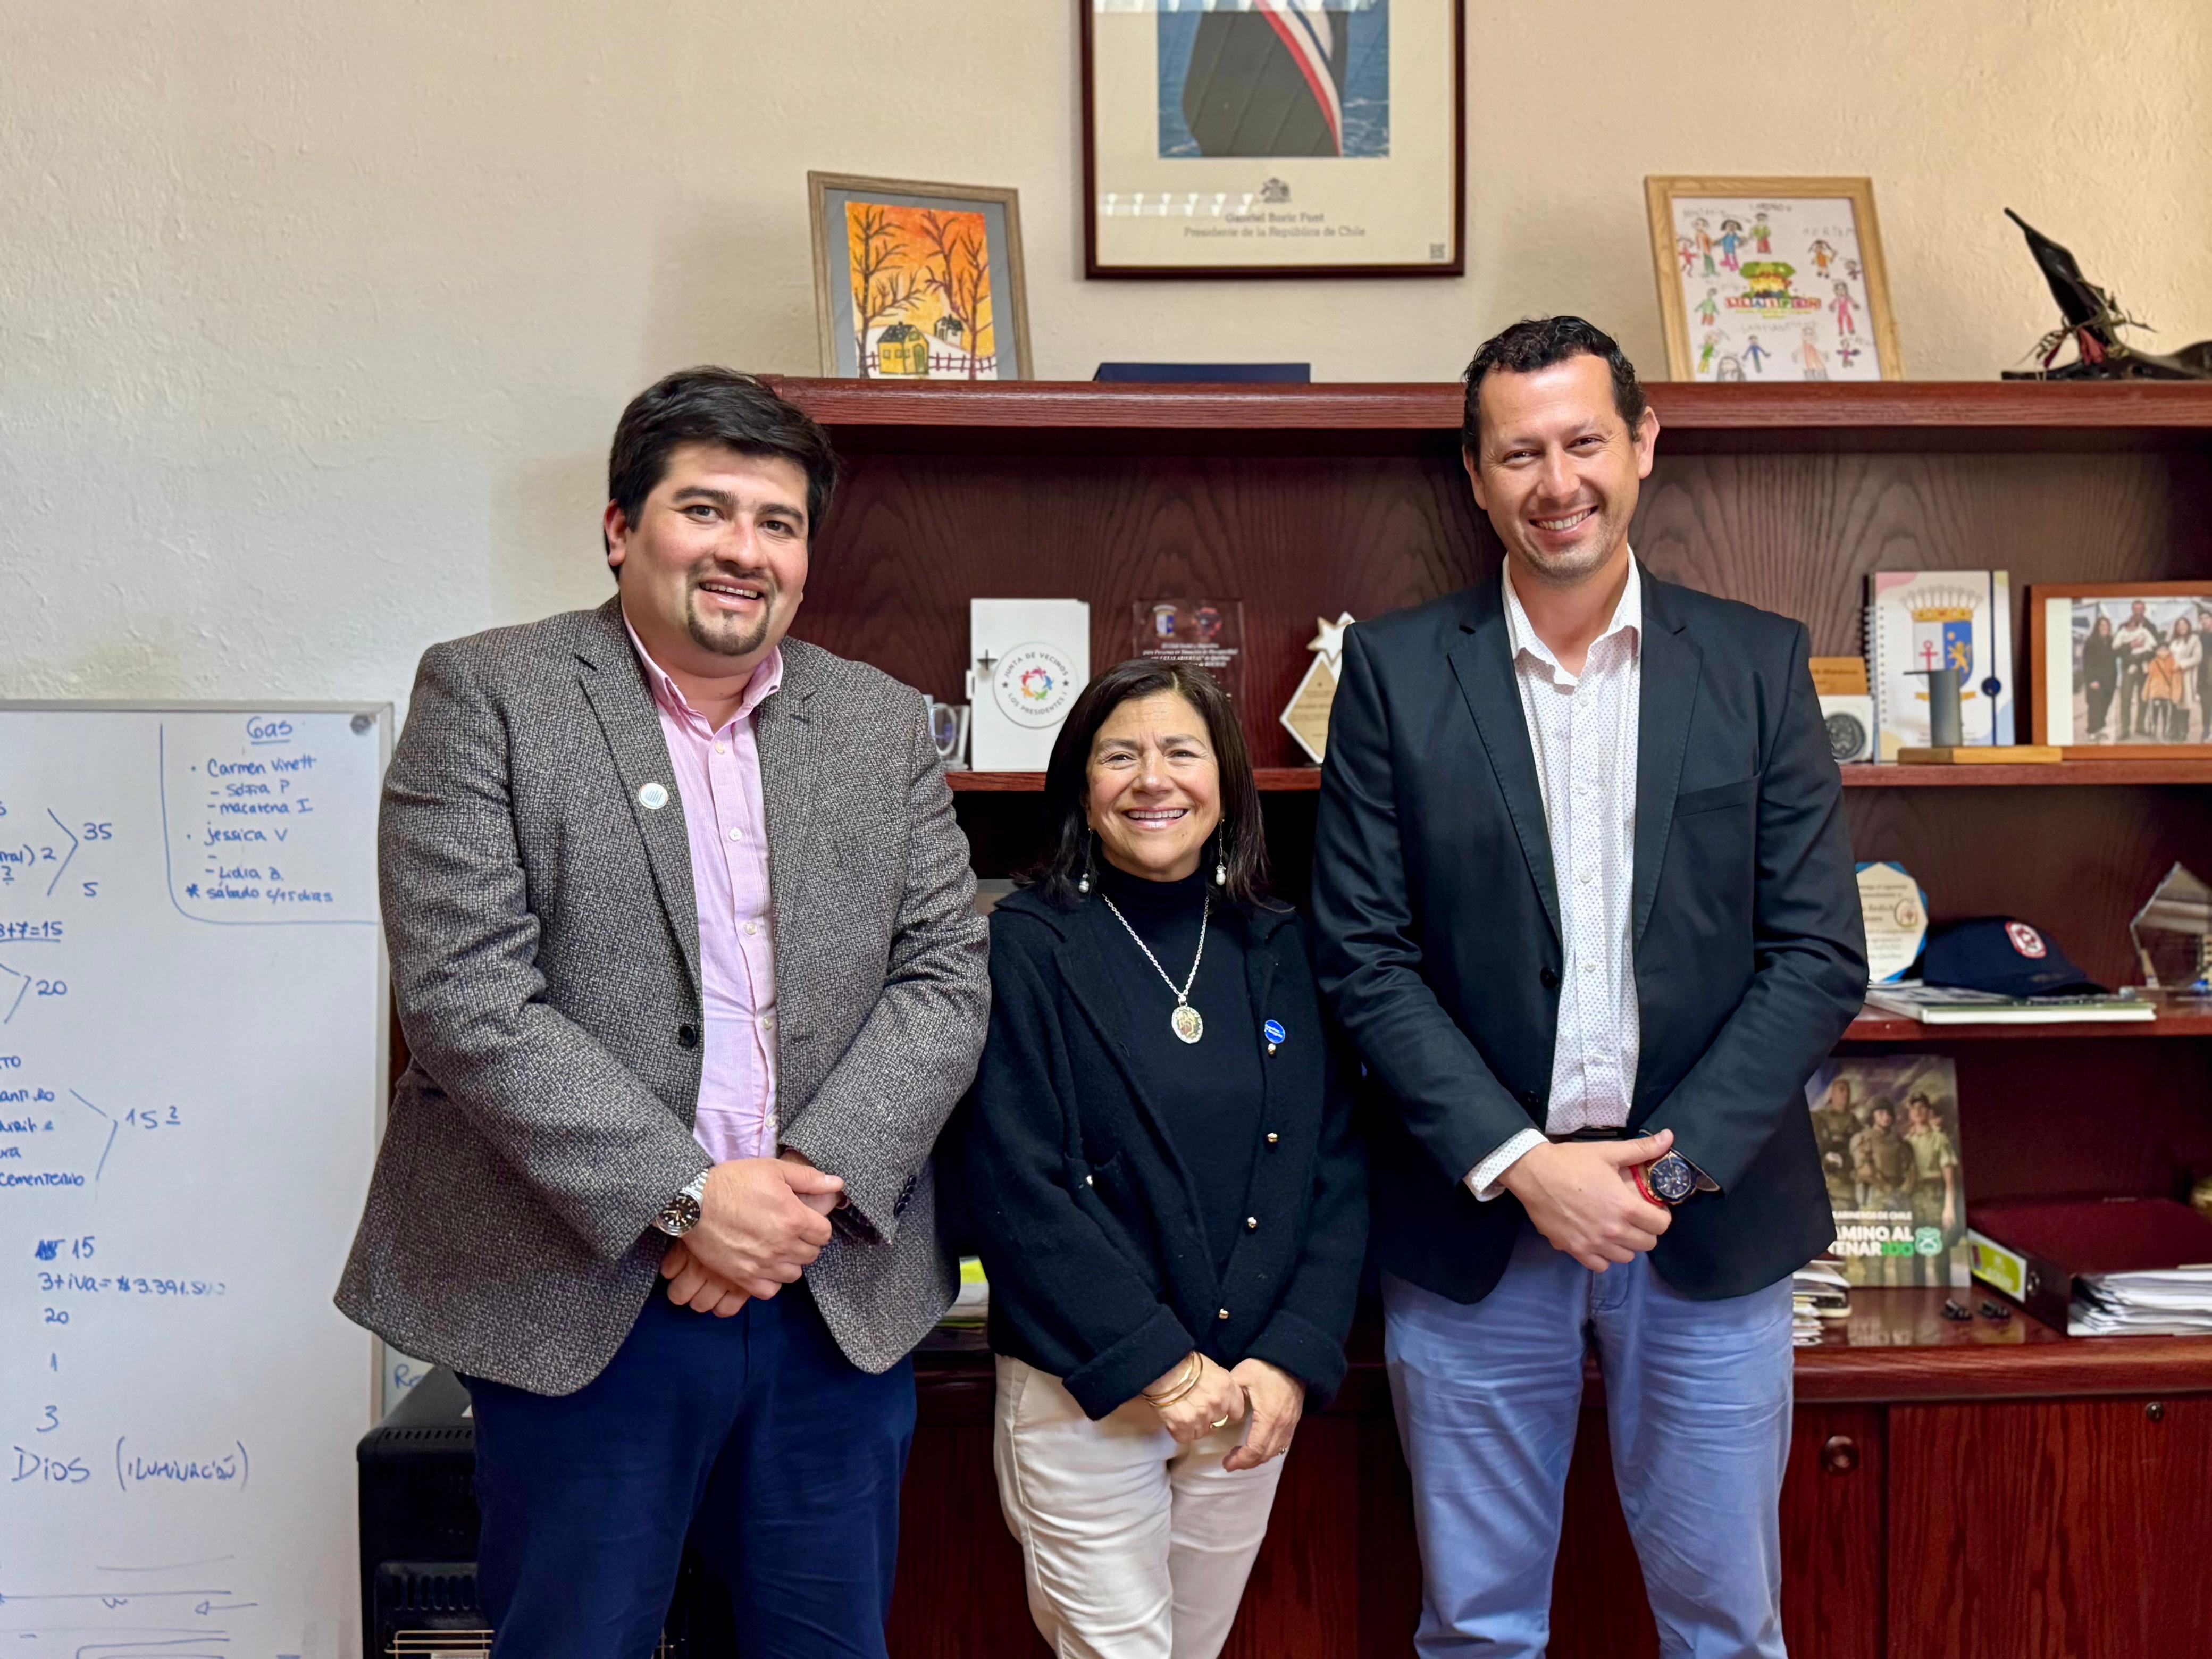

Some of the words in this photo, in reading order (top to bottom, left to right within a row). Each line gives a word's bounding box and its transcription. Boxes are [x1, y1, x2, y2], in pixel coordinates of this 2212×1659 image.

[1004, 657, 1023, 678] JUNTA
[1039, 652, 1069, 676] VECINOS
[1008, 693, 1020, 707] LOS
[1020, 696, 1065, 715] PRESIDENTES
[247, 716, 293, 739] Gas
[207, 758, 266, 777] Carmen
[280, 778, 290, 793] P
[83, 822, 112, 840] 35
[40, 847, 57, 860] 2
[36, 980, 68, 995] 20
[125, 1107, 158, 1129] 15
[1891, 1226, 1914, 1241] AL
[72, 1235, 95, 1260] 15
[44, 1308, 70, 1325] 20
[36, 1405, 60, 1432] 3
